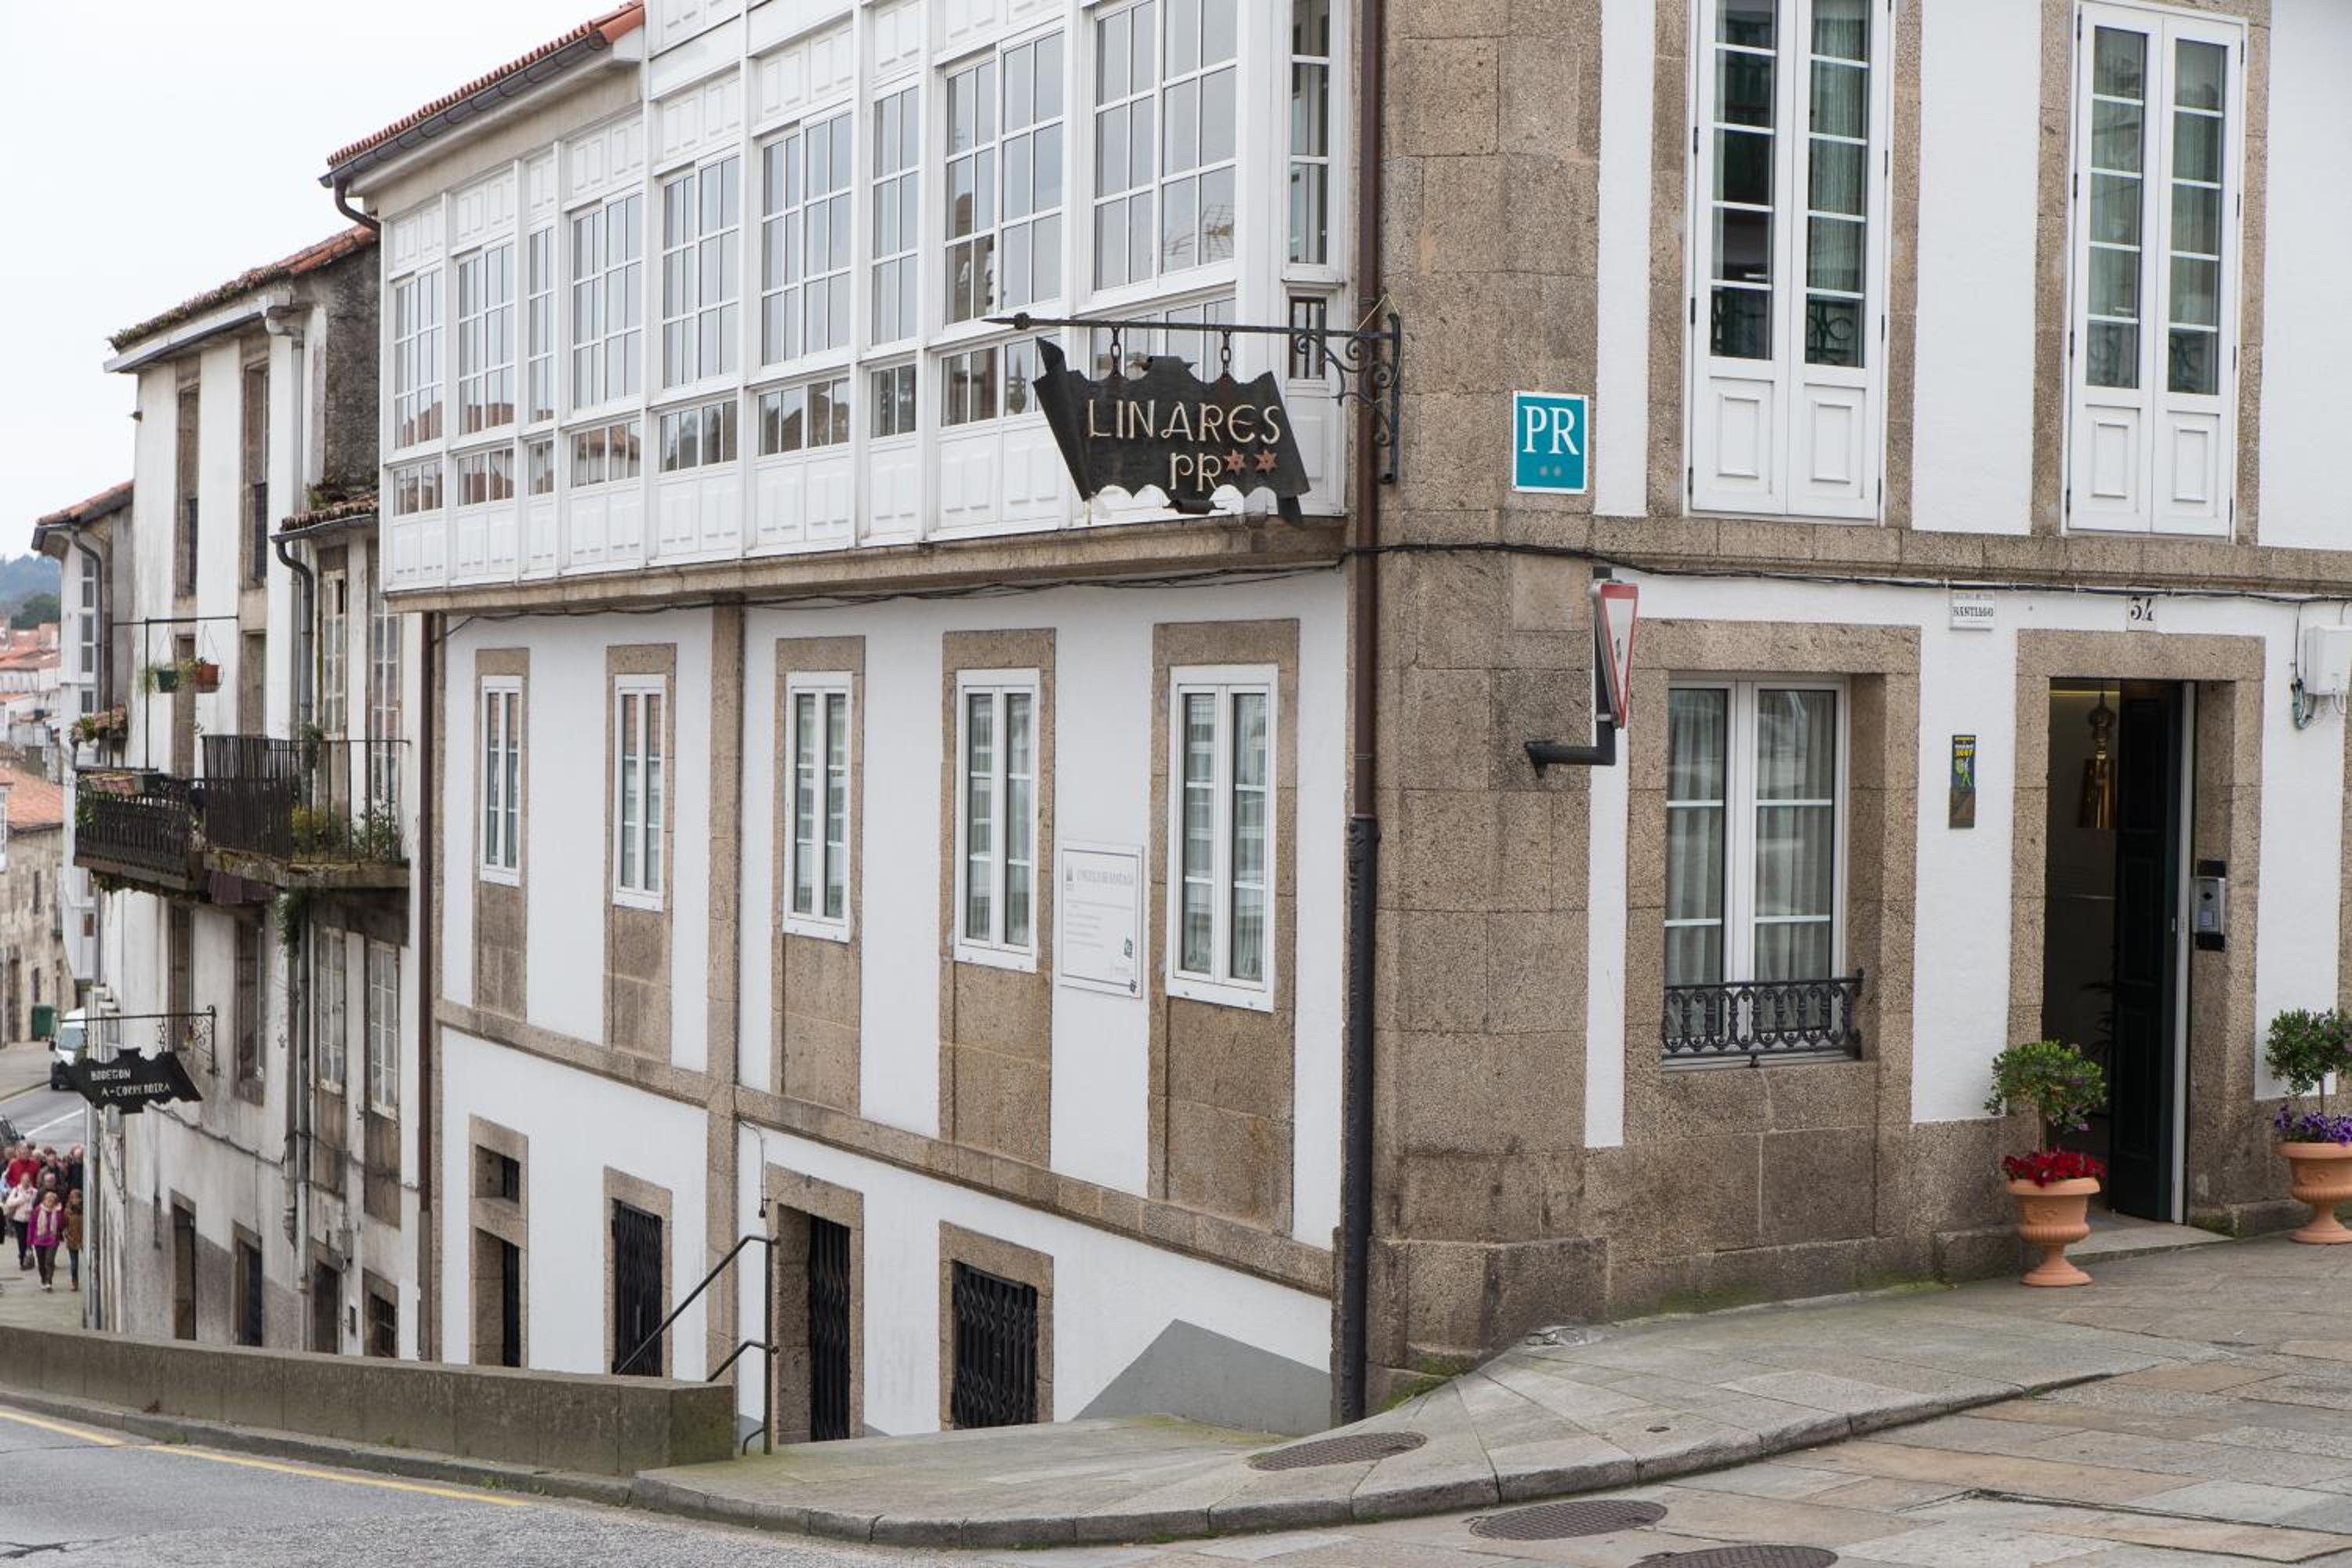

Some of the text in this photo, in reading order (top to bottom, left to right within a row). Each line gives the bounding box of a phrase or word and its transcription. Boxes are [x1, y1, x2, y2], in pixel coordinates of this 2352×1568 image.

[1088, 399, 1281, 444] LINARES
[1519, 405, 1581, 456] PR
[1170, 452, 1221, 492] PR
